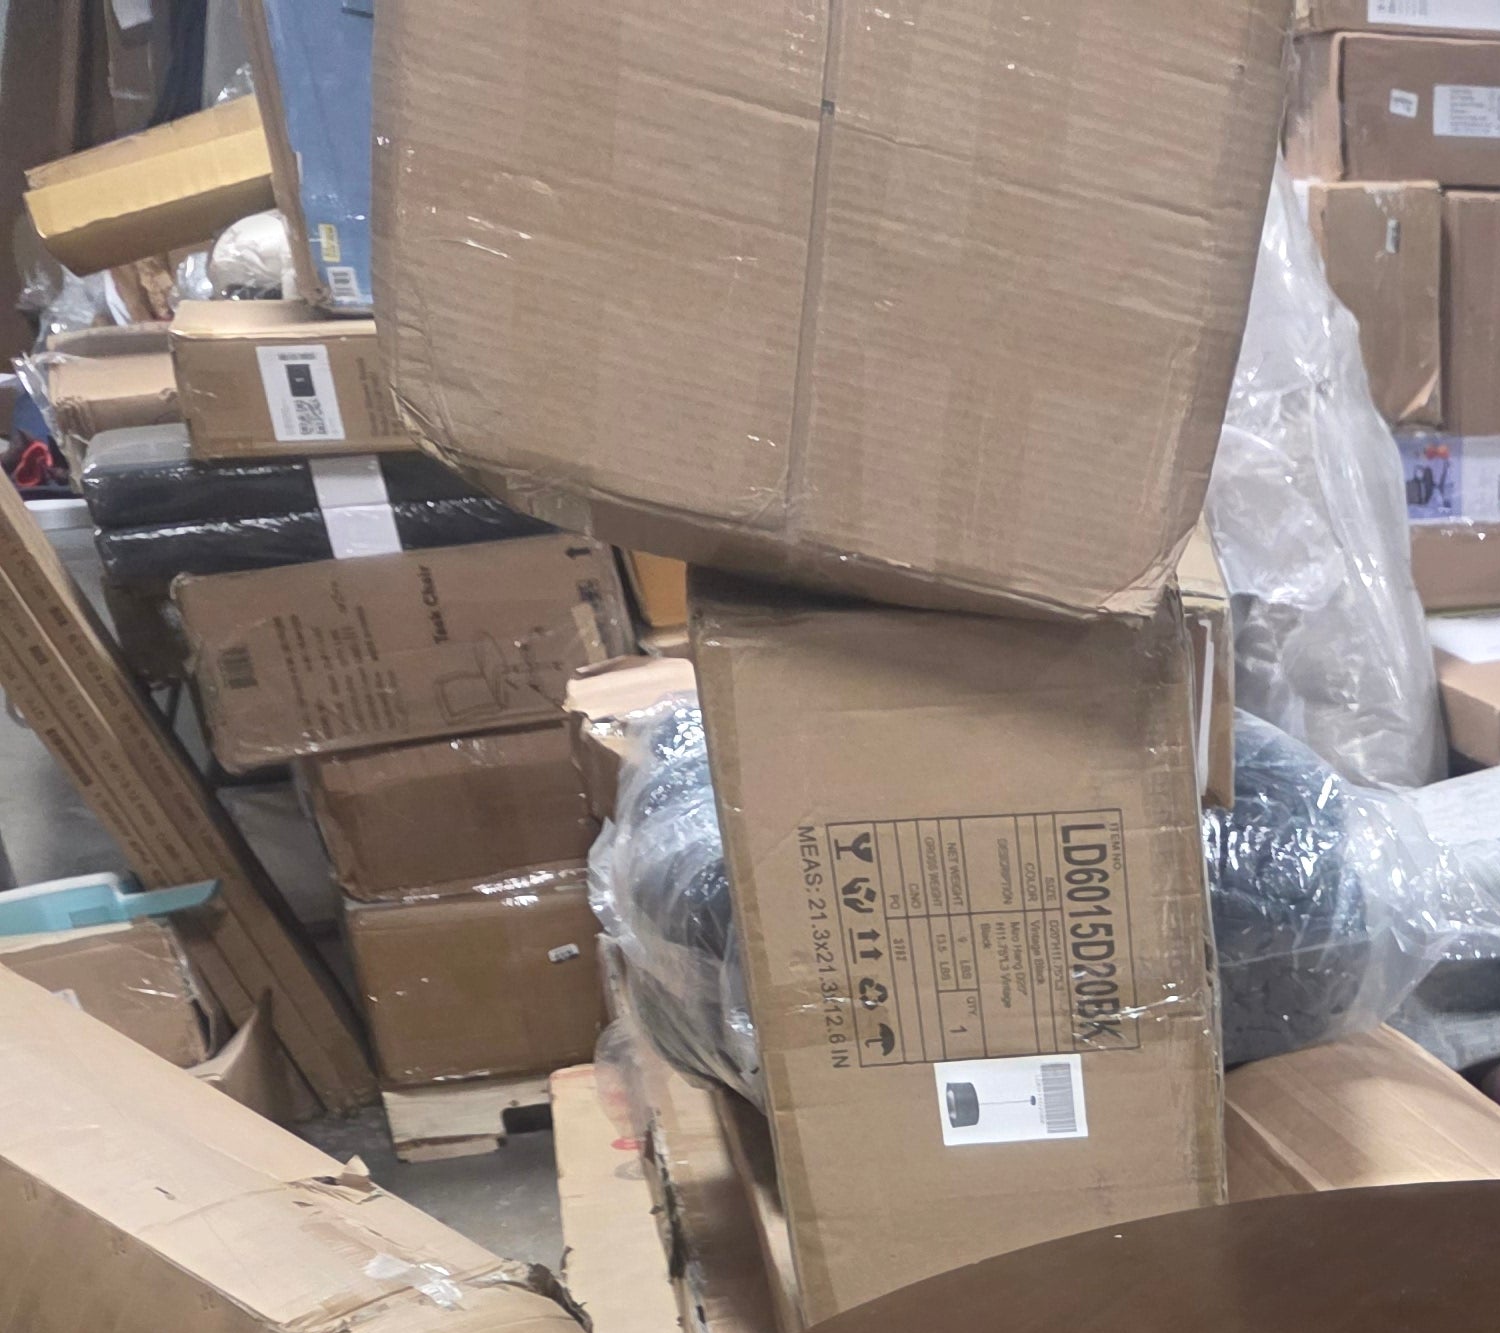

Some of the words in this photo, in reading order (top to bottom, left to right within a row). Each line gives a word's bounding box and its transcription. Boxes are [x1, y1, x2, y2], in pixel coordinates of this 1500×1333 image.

[417, 565, 439, 607] Chair
[1109, 822, 1121, 851] ITEM
[797, 825, 823, 893] MEAS:
[945, 841, 960, 868] NET
[949, 868, 964, 907] WEIGHT
[1024, 861, 1039, 903] COLOR
[1044, 876, 1057, 902] SIZE
[979, 923, 992, 950] Black
[1029, 919, 1042, 957] Vintage
[1060, 823, 1123, 1041] LD6015D20BK
[808, 897, 847, 1045] 21.3x21.3x12.6
[938, 960, 952, 982] LBS
[959, 959, 973, 981] LBS
[1033, 958, 1046, 986] Black
[1000, 973, 1012, 1009] Vintage
[950, 1025, 968, 1035] 1
[831, 1048, 851, 1069] IN
